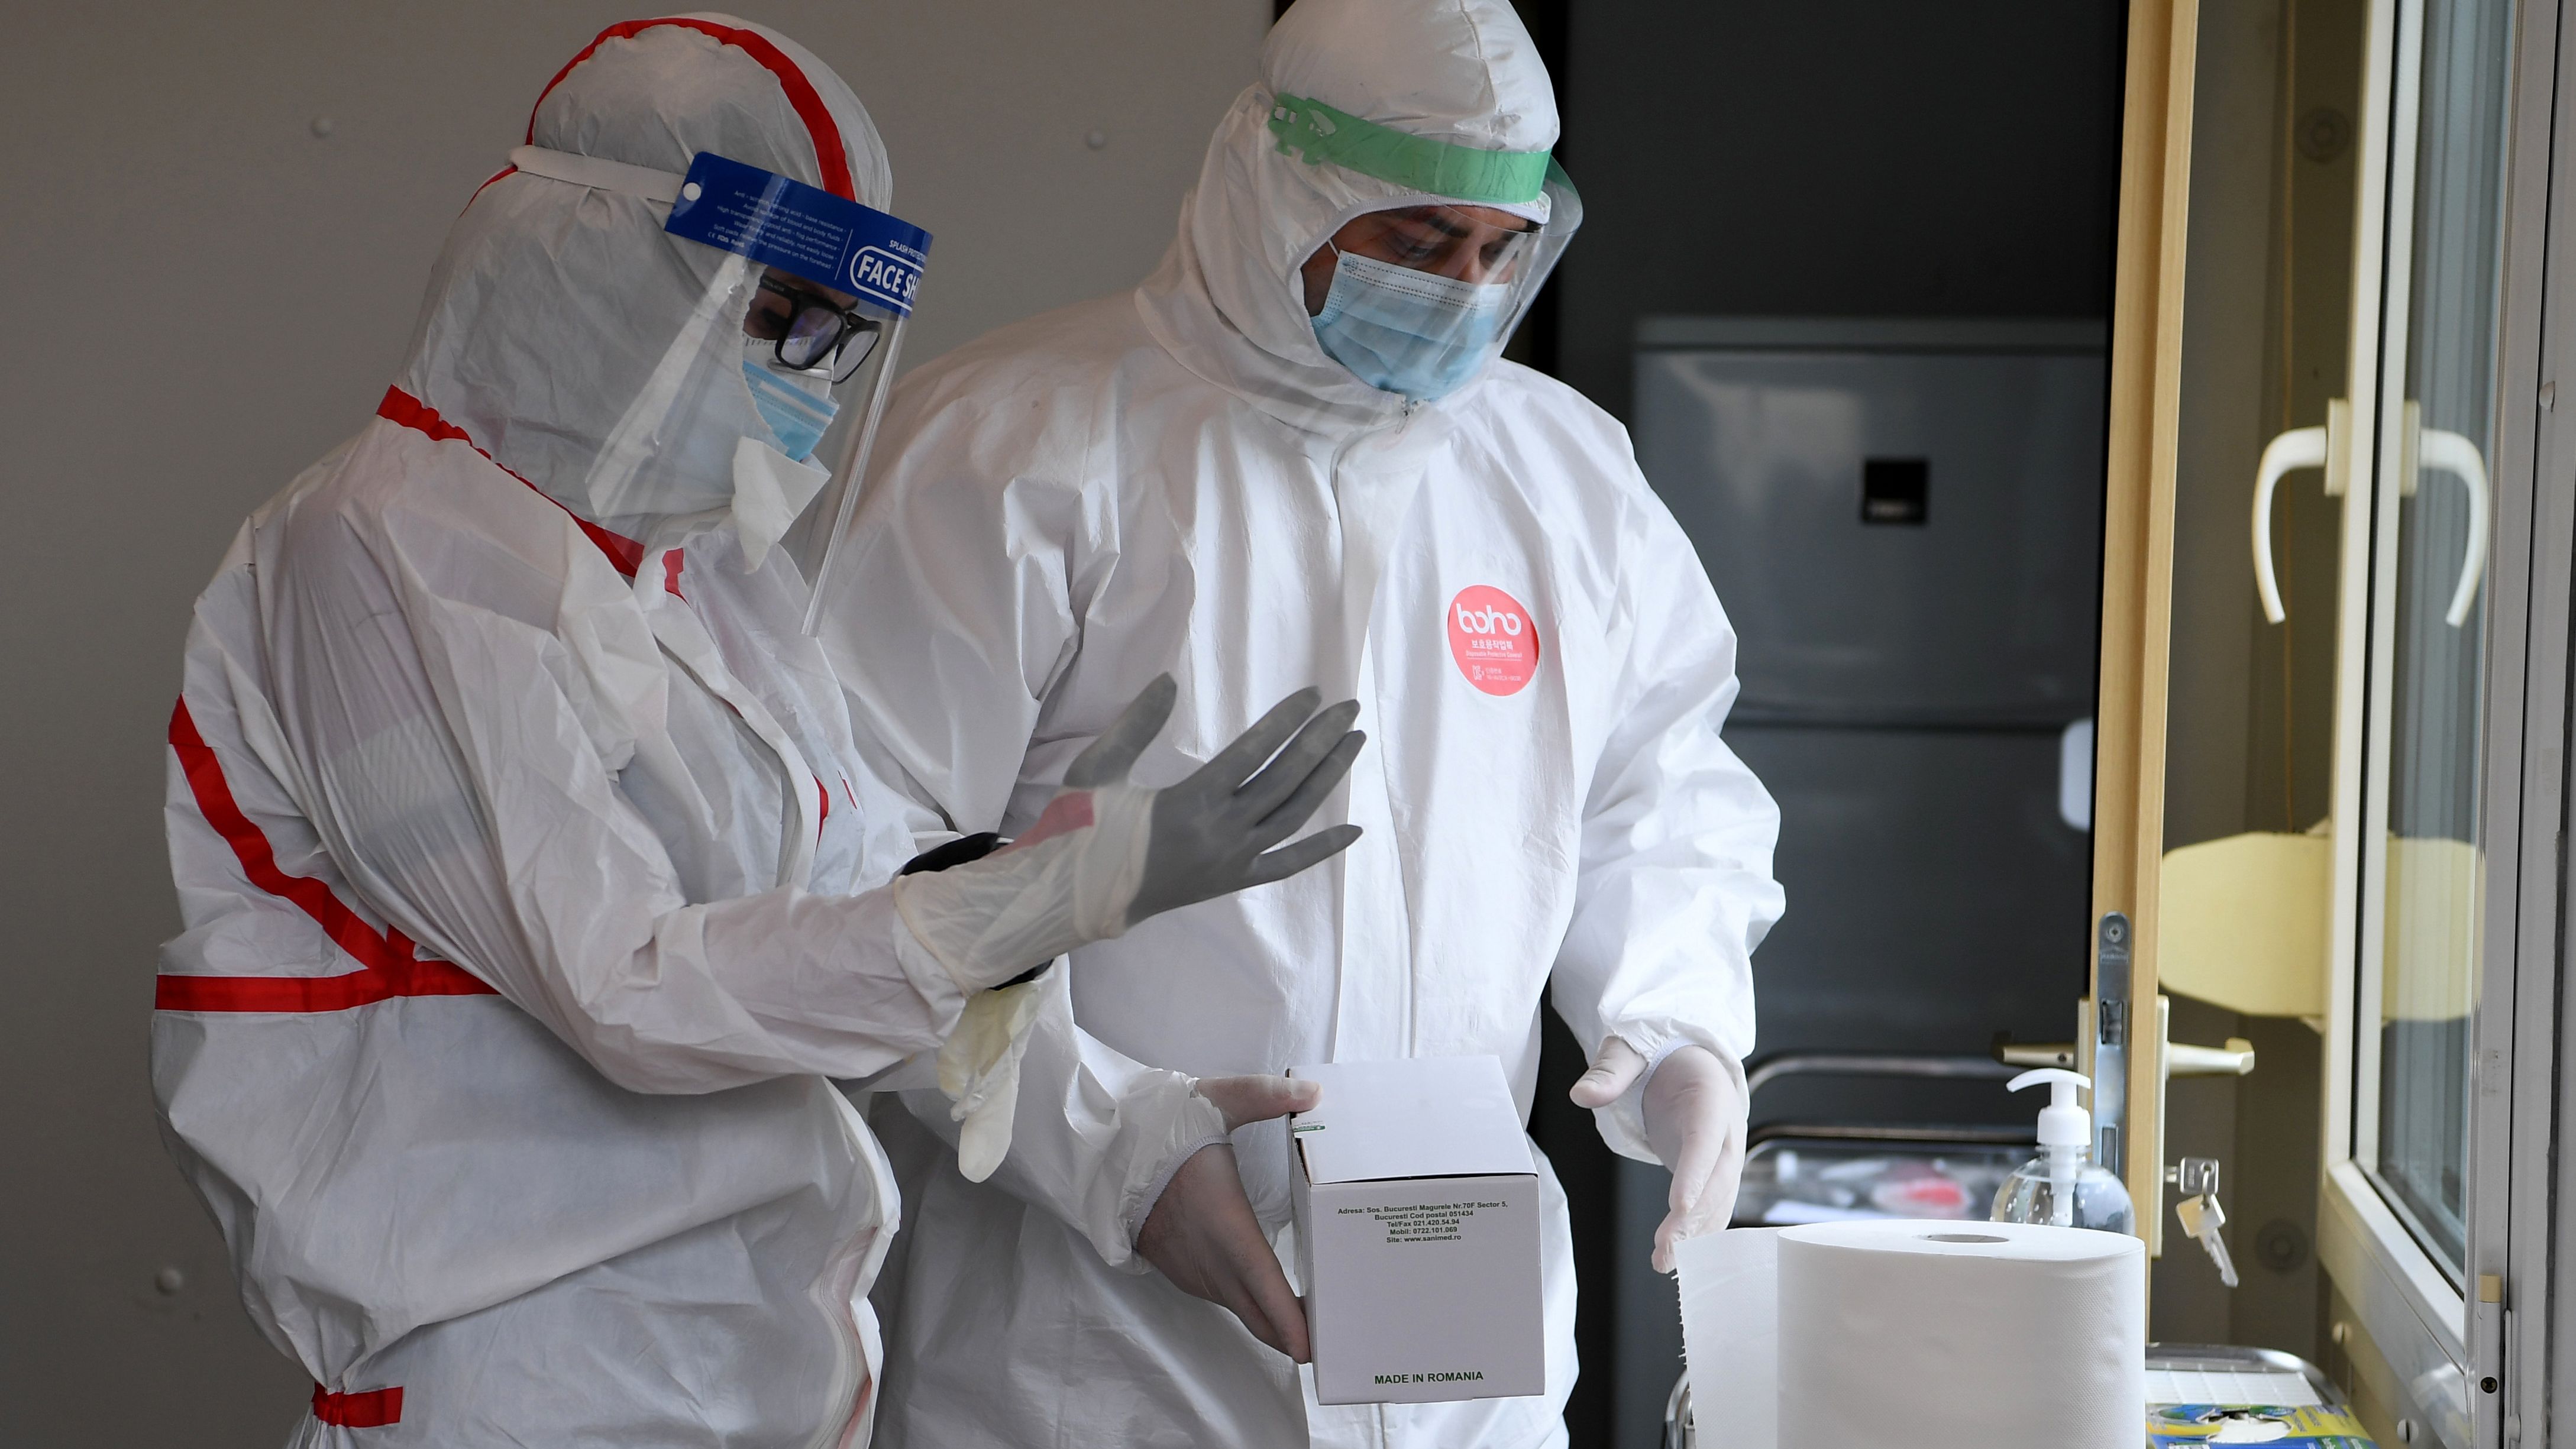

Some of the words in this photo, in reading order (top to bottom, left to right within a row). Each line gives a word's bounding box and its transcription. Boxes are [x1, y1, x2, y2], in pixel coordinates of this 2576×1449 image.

[889, 240, 908, 253] SPLASH
[857, 255, 904, 293] FACE
[902, 273, 920, 300] SH
[1456, 603, 1521, 635] boho
[1426, 1211, 1447, 1220] postal
[1375, 1374, 1409, 1384] MADE
[1413, 1374, 1424, 1383] IN
[1428, 1372, 1483, 1382] ROMANIA
